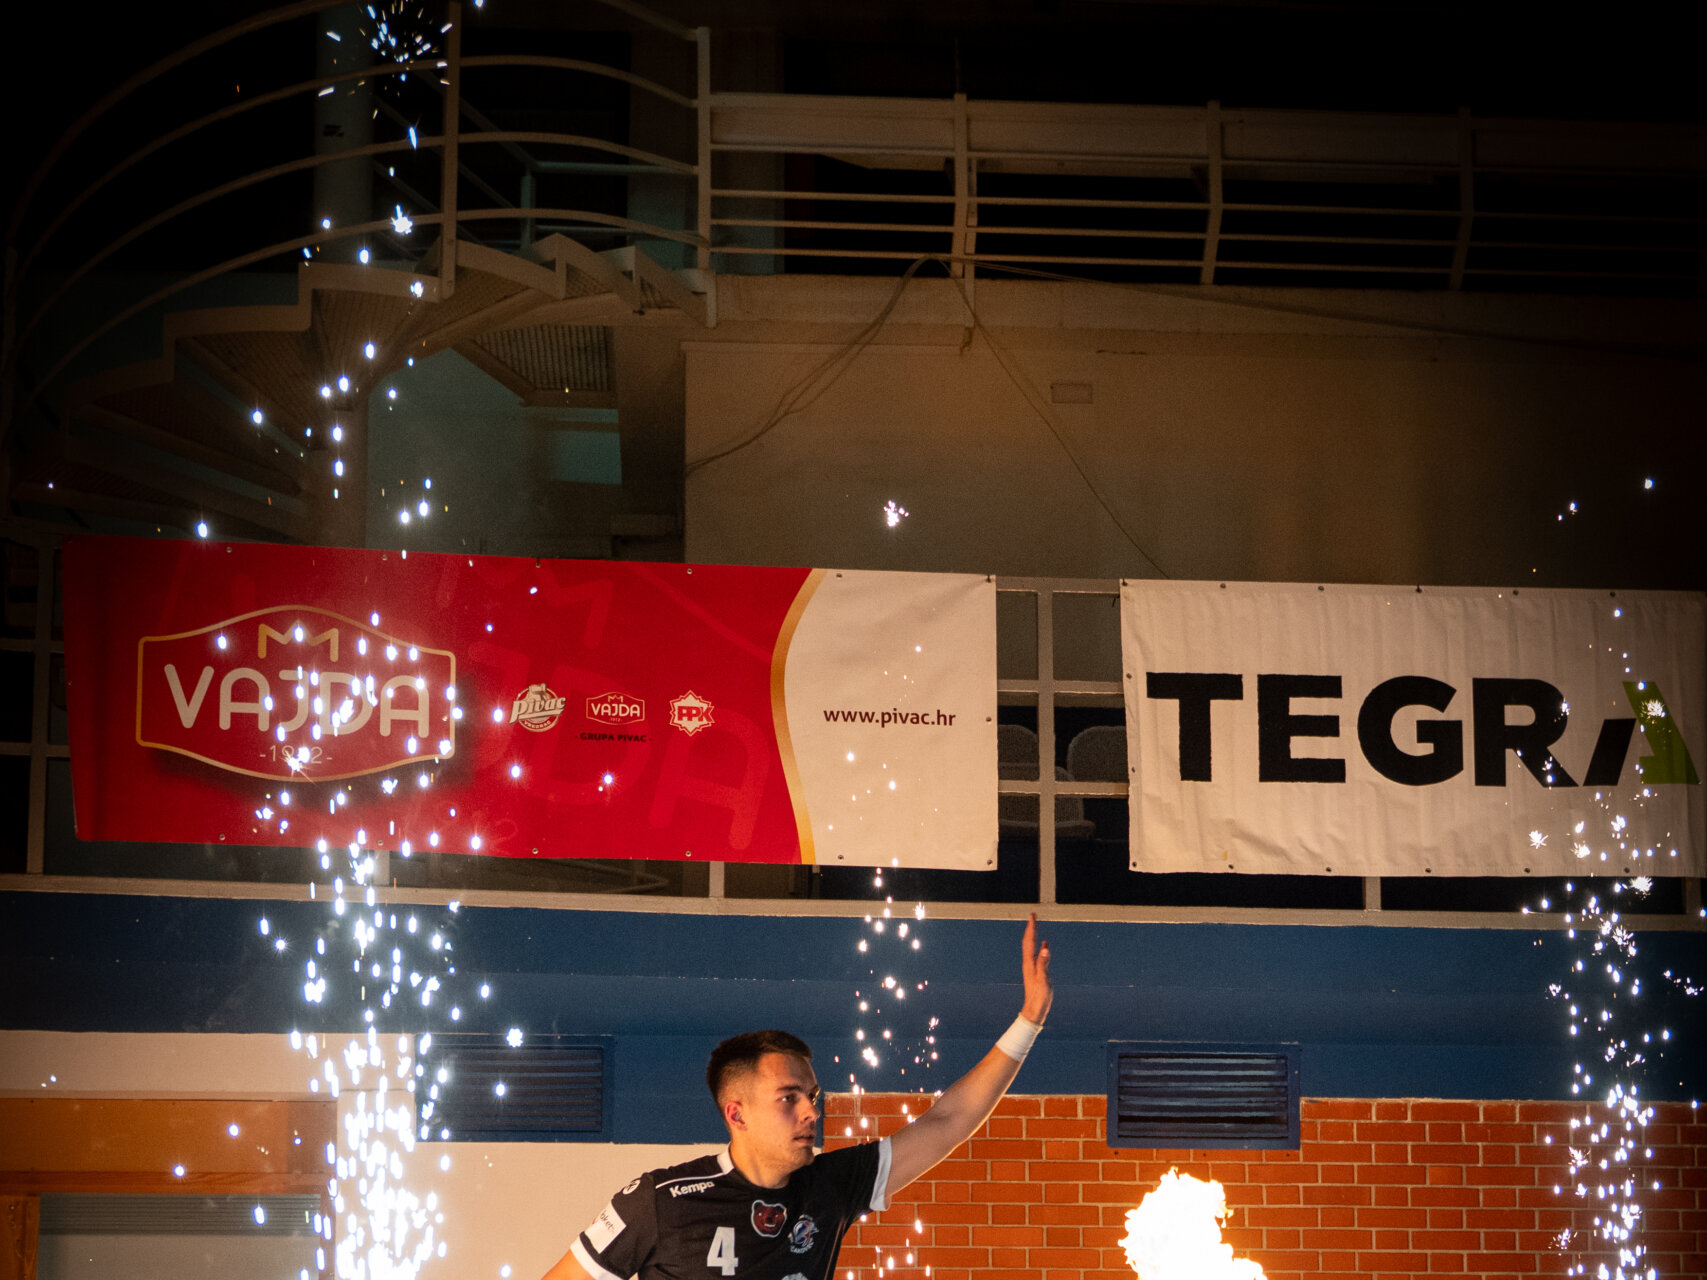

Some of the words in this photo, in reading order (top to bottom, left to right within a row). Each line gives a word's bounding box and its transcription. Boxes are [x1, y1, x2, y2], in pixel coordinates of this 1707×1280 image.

[164, 664, 430, 738] VAJDA
[590, 703, 641, 717] VAJDA
[677, 705, 714, 722] PPK
[823, 707, 957, 728] www.pivac.hr
[580, 732, 615, 741] GRUPA
[617, 734, 647, 742] PIVAC
[1146, 671, 1701, 788] TEGRA
[669, 1180, 715, 1198] Kempa
[706, 1226, 739, 1276] 4
